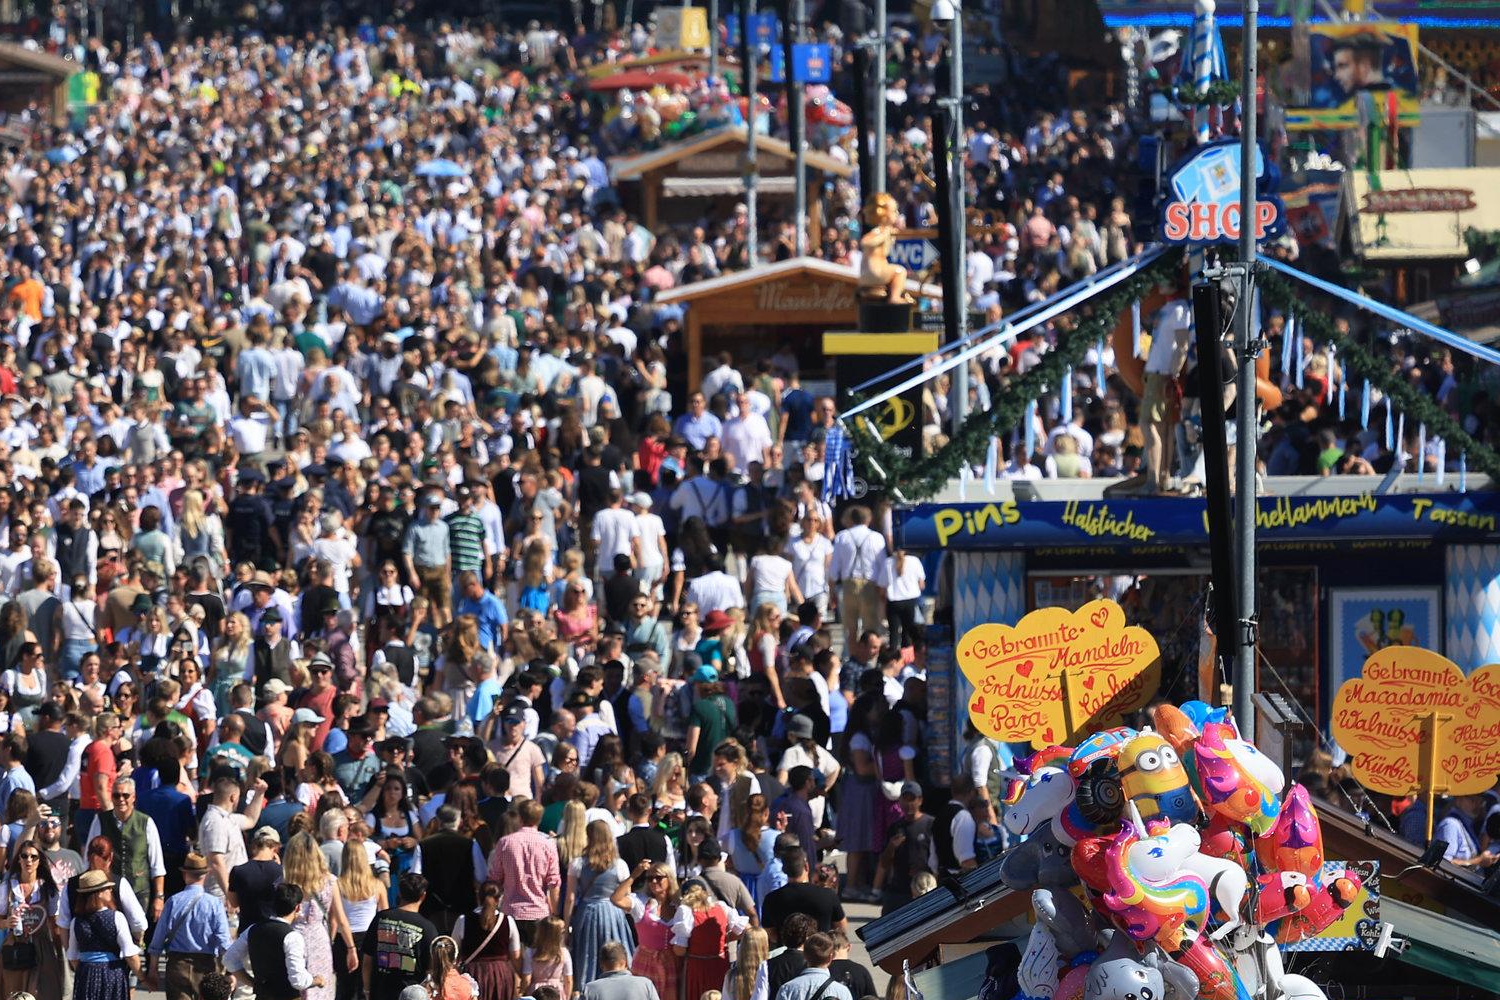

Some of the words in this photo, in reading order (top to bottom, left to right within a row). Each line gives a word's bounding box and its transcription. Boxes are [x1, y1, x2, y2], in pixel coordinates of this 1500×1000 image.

[1164, 200, 1278, 241] SHOP
[933, 500, 1022, 547] Pins
[1061, 499, 1156, 542] Halstücher
[1412, 498, 1495, 531] Tassen
[972, 623, 1081, 660] Gebrannte
[1049, 634, 1143, 670] Mandeln
[982, 674, 1069, 702] Erdnüsse
[1367, 661, 1459, 688] Gebrannte
[1345, 683, 1465, 708] Macadamia
[990, 703, 1049, 733] Para
[1338, 708, 1431, 745] Walnüsse
[1355, 751, 1417, 784] Kürbis
